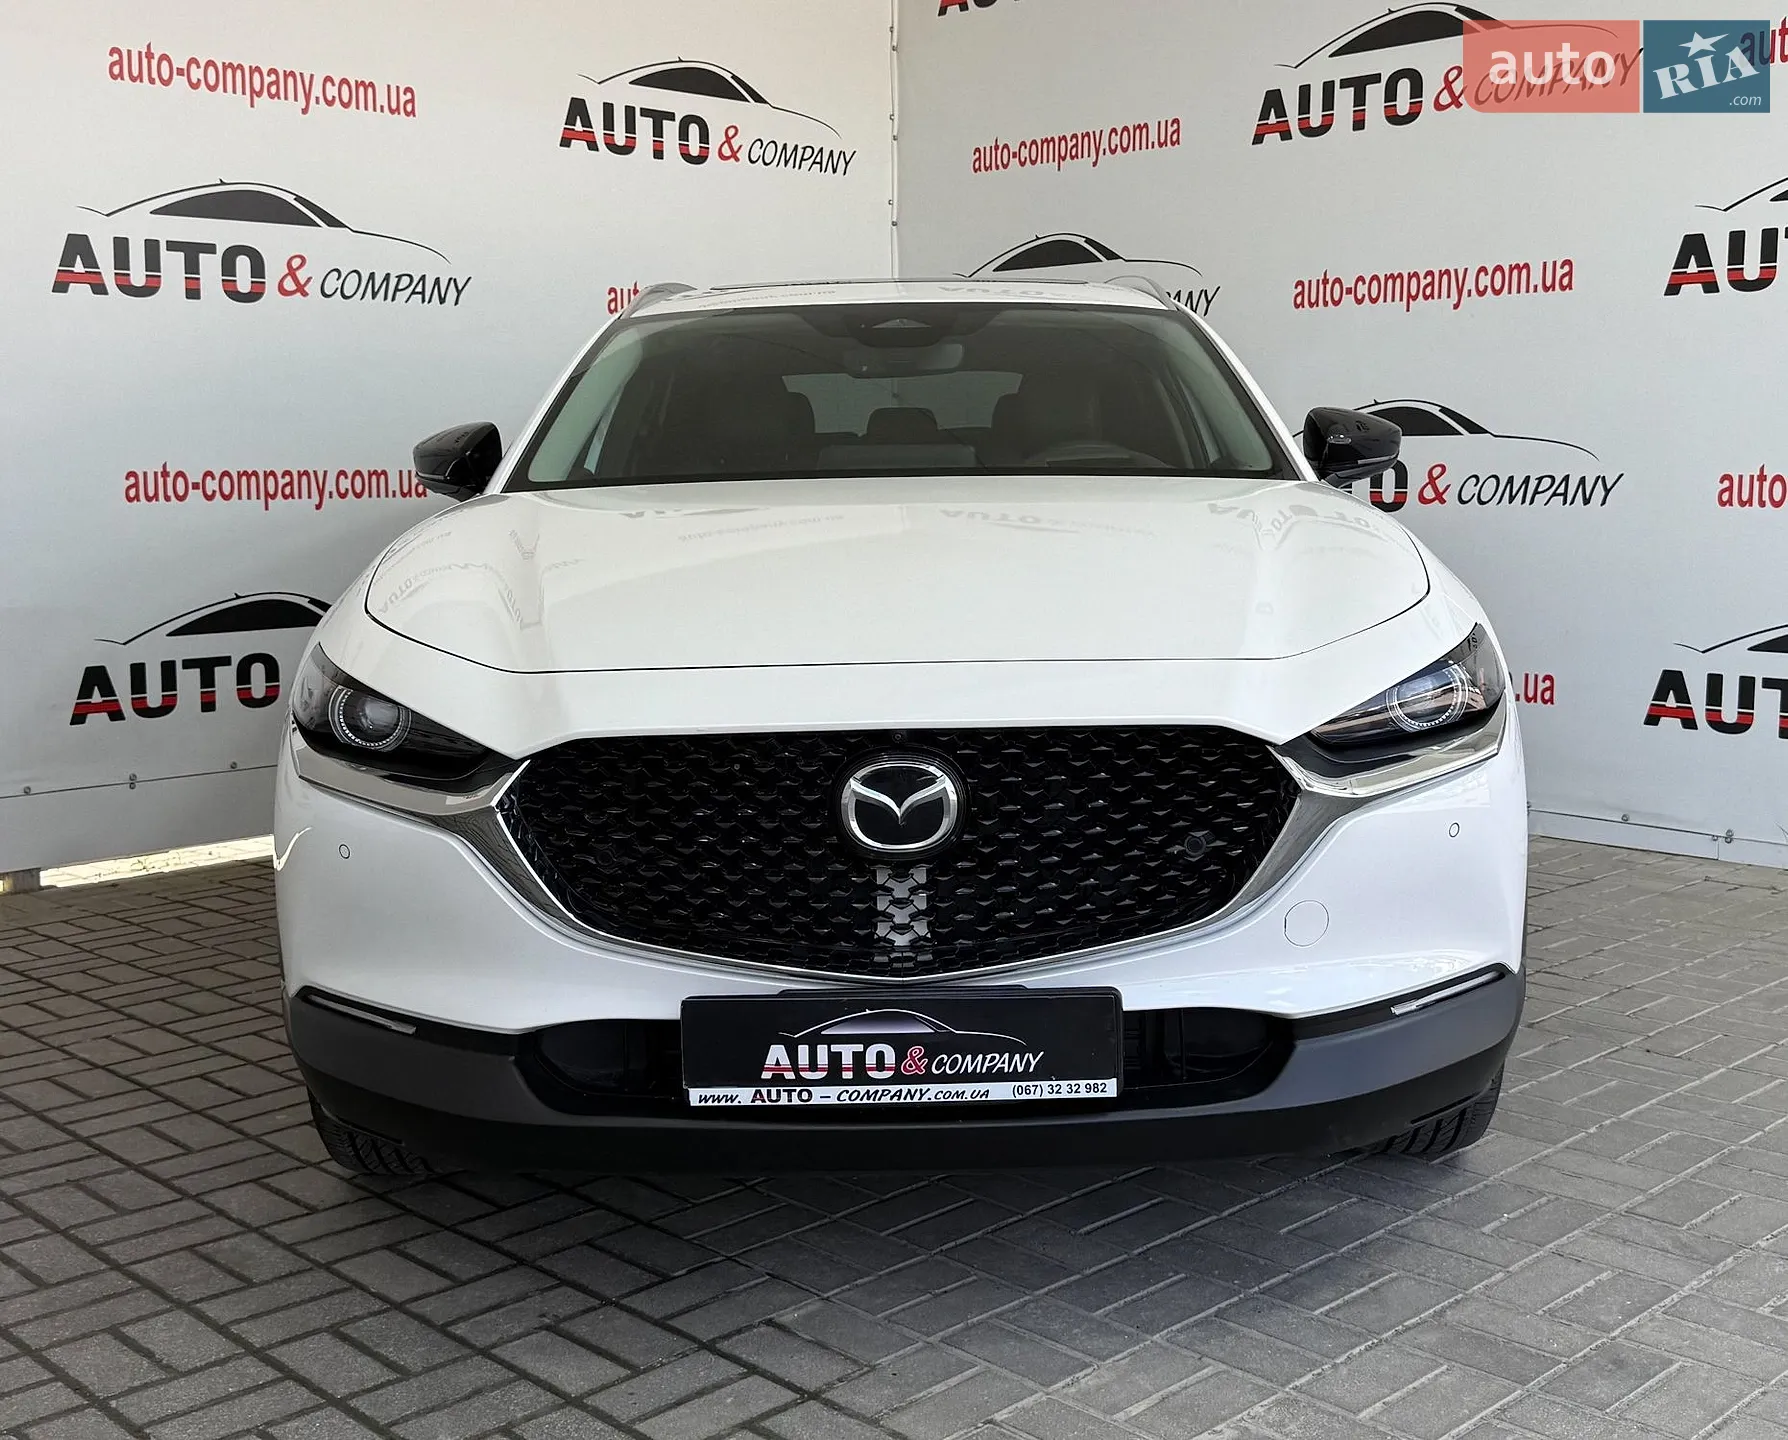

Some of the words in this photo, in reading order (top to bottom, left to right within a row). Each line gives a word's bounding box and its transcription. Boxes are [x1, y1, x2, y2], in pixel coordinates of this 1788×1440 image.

[108, 43, 417, 118] auto-company.com.ua
[1251, 67, 1424, 146] AUTO
[1433, 65, 1467, 112] &
[558, 96, 711, 165] AUTO
[716, 124, 744, 162] &
[747, 138, 857, 177] COMPANY
[972, 117, 1182, 174] auto-company.com.ua
[51, 233, 267, 304] AUTO
[277, 253, 313, 298] &
[319, 267, 473, 307] COMPANY
[1293, 259, 1575, 312] auto-company.com.ua
[1663, 227, 1788, 297] AU
[1417, 463, 1451, 506] &
[1457, 472, 1625, 508] COMPANY
[69, 652, 281, 726] AUTO
[760, 1043, 897, 1080] AUTO
[900, 1045, 928, 1076] &
[931, 1050, 1045, 1075] COMPANY
[1012, 1083, 1044, 1099] (067)
[1047, 1083, 1062, 1096] 32
[1066, 1083, 1082, 1095] 32
[1084, 1082, 1108, 1094] 982
[698, 1092, 742, 1104] www.
[750, 1088, 813, 1104] AUTO
